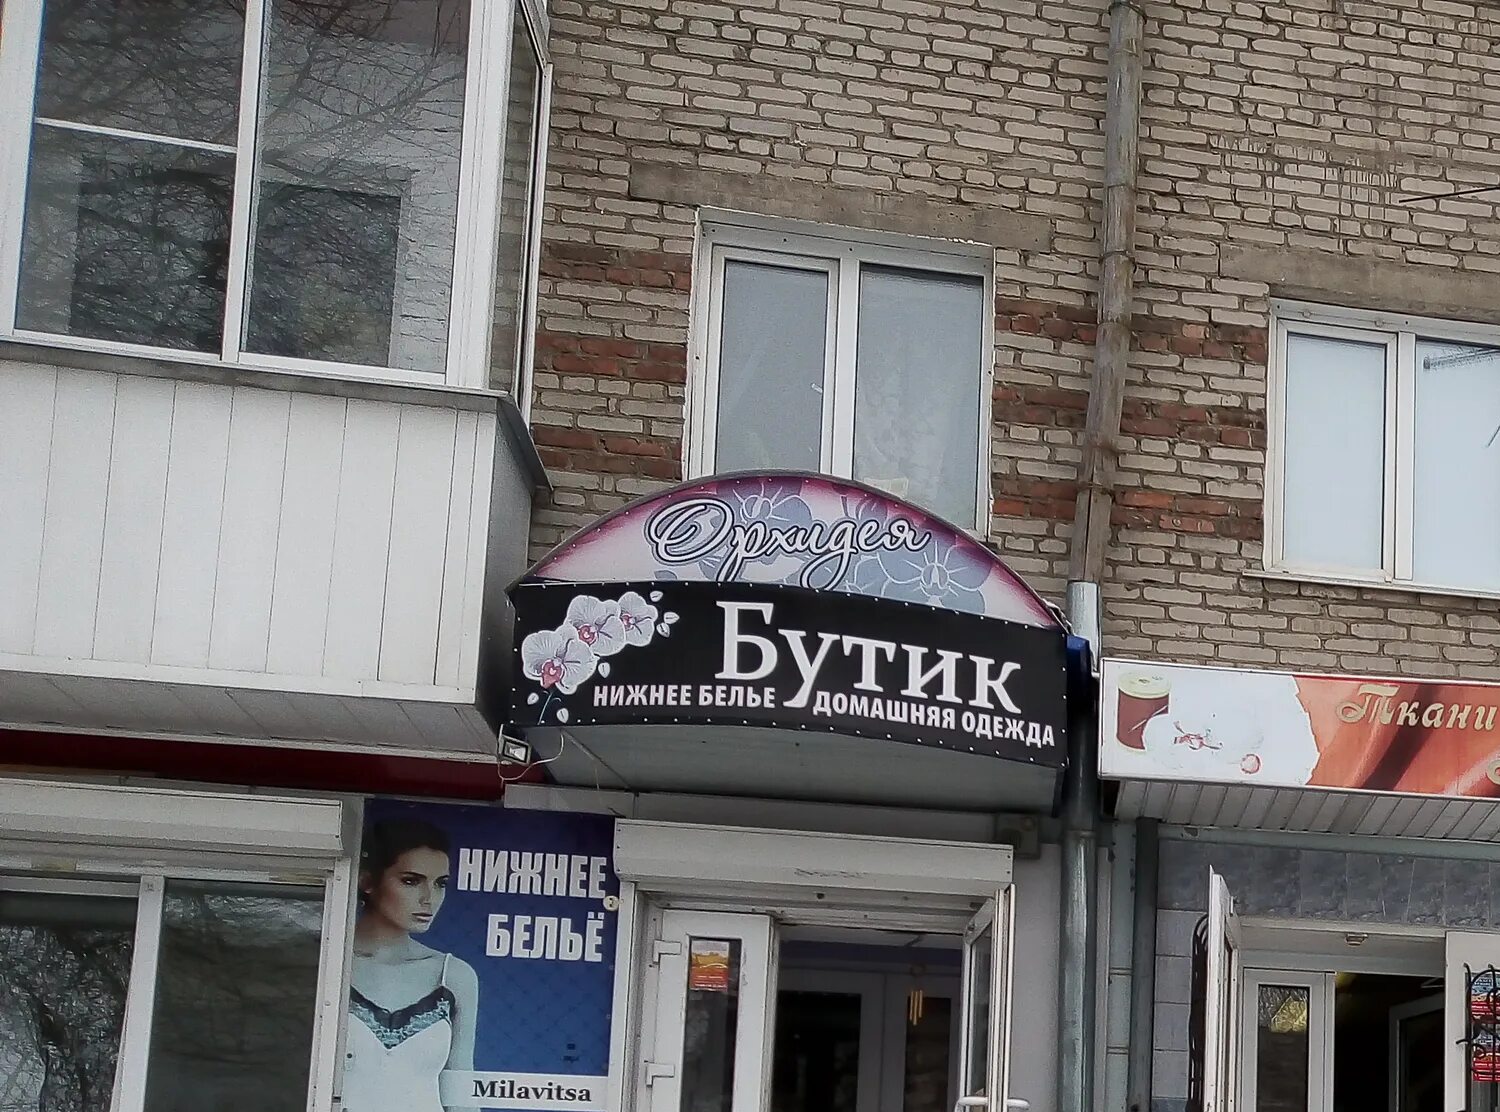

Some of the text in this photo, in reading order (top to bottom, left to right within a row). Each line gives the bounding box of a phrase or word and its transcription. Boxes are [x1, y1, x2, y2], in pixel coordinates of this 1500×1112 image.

[646, 498, 931, 591] Орхидея
[593, 684, 1056, 748] НИЖНЕЕ БЕЛЬЕ ДОМАШНЯЯ ОДЕЖДА
[1336, 683, 1498, 731] Ткани
[457, 847, 607, 899] НИЖНЕЕ
[486, 911, 605, 962] БЕЛЬЁ
[472, 1079, 592, 1102] Milavitsa
